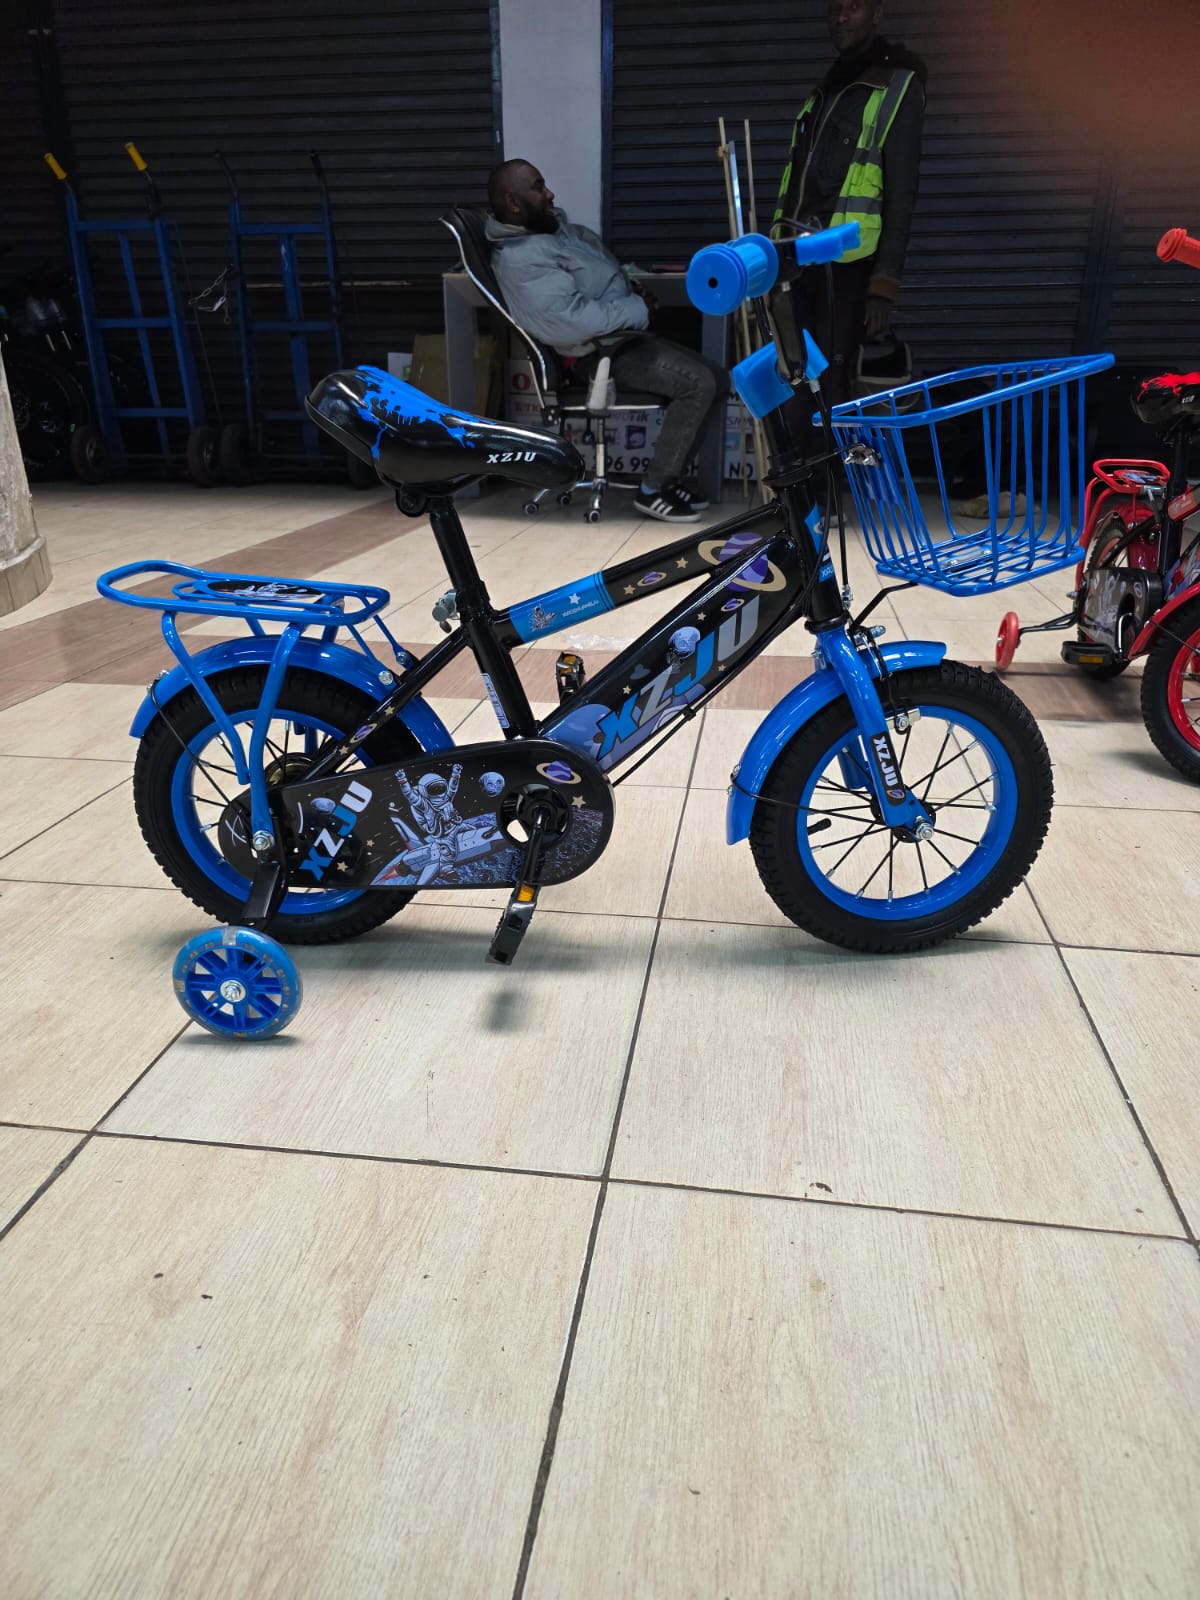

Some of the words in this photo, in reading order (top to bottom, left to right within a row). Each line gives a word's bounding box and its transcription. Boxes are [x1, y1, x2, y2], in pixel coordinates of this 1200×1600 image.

[486, 451, 537, 464] XZJU
[596, 595, 760, 761] XZJU
[873, 735, 899, 787] XZJU
[299, 780, 373, 880] XZJU
